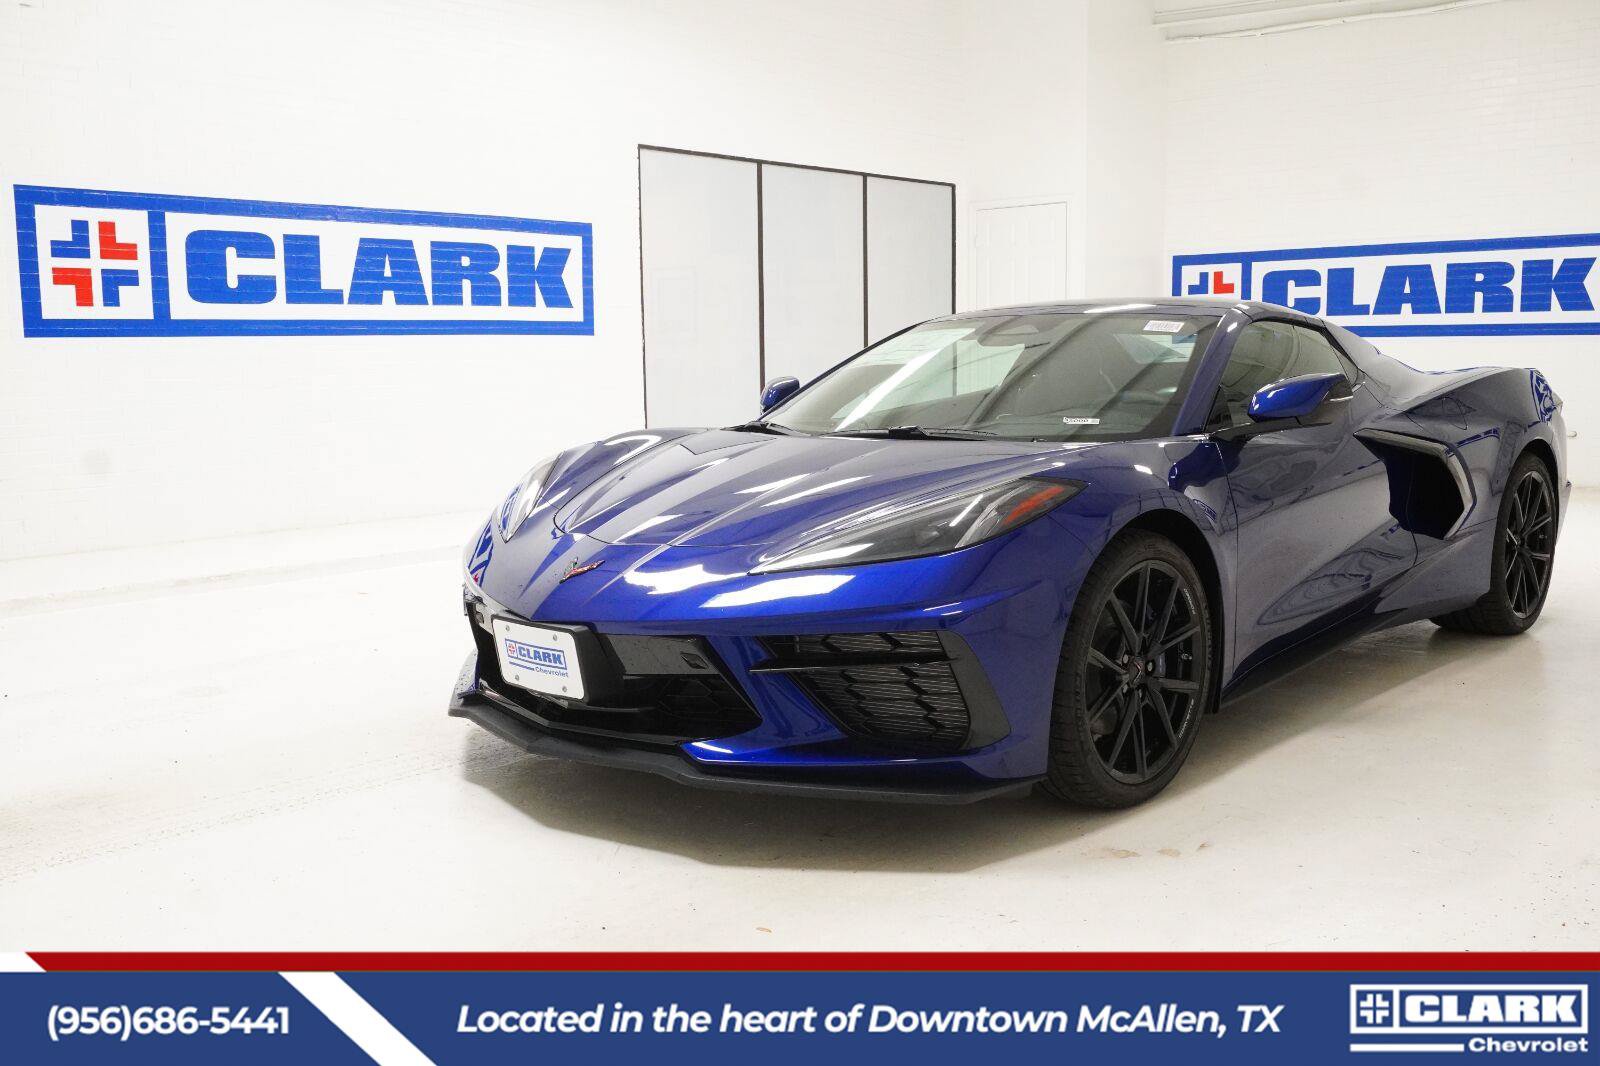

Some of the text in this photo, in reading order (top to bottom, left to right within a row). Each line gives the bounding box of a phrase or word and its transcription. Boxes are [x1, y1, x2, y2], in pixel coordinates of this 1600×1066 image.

[185, 229, 574, 309] CLARK
[1262, 257, 1597, 316] CLARK
[518, 646, 563, 665] CLARK
[535, 666, 569, 678] Chevrolet
